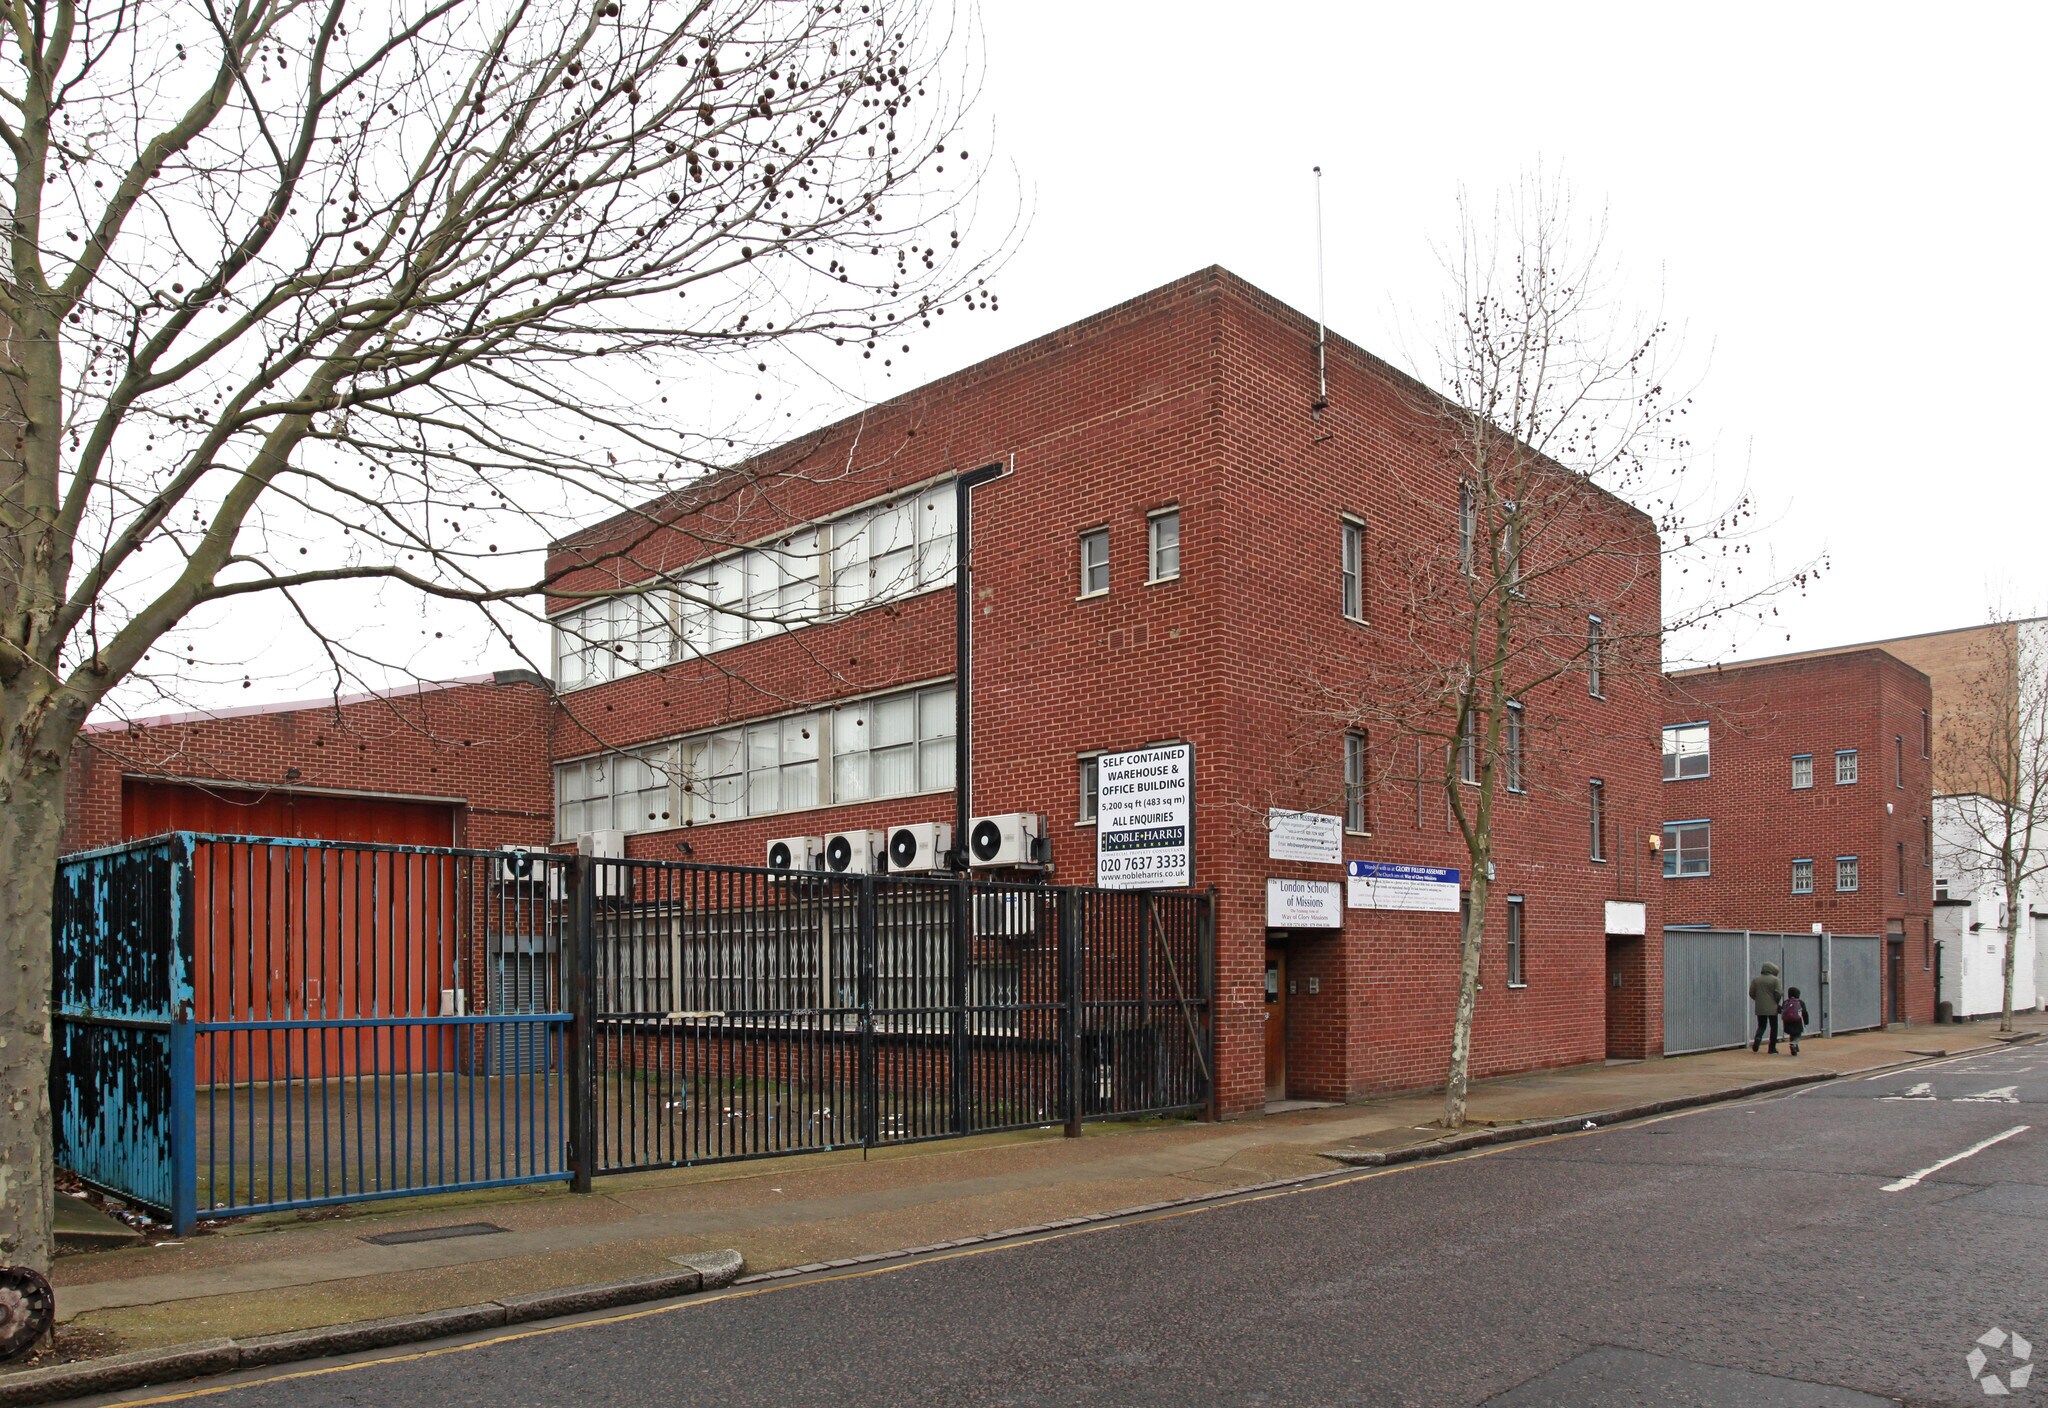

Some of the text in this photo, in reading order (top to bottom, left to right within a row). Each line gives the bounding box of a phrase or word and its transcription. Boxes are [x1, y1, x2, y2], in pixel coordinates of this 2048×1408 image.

[1103, 749, 1185, 768] SELF CONTAINED
[1108, 764, 1179, 781] WAREHOUSE &
[1102, 778, 1185, 796] OFFICE BUILDING
[1102, 801, 1122, 811] 5,200
[1124, 802, 1133, 810] sq
[1135, 799, 1142, 808] ft
[1143, 797, 1161, 808] (483
[1174, 795, 1185, 805] m)
[1112, 811, 1174, 827] ALL ENQUIRIES
[1108, 831, 1140, 844] NOBLE
[1144, 828, 1183, 841] HARRIS
[1108, 840, 1183, 850] PARTNERSHIP
[1101, 854, 1186, 872] 020 7637 3333
[1101, 869, 1185, 881] www.nobleharris.co.uk
[1280, 881, 1329, 893] London School
[1286, 895, 1323, 907] of Missions
